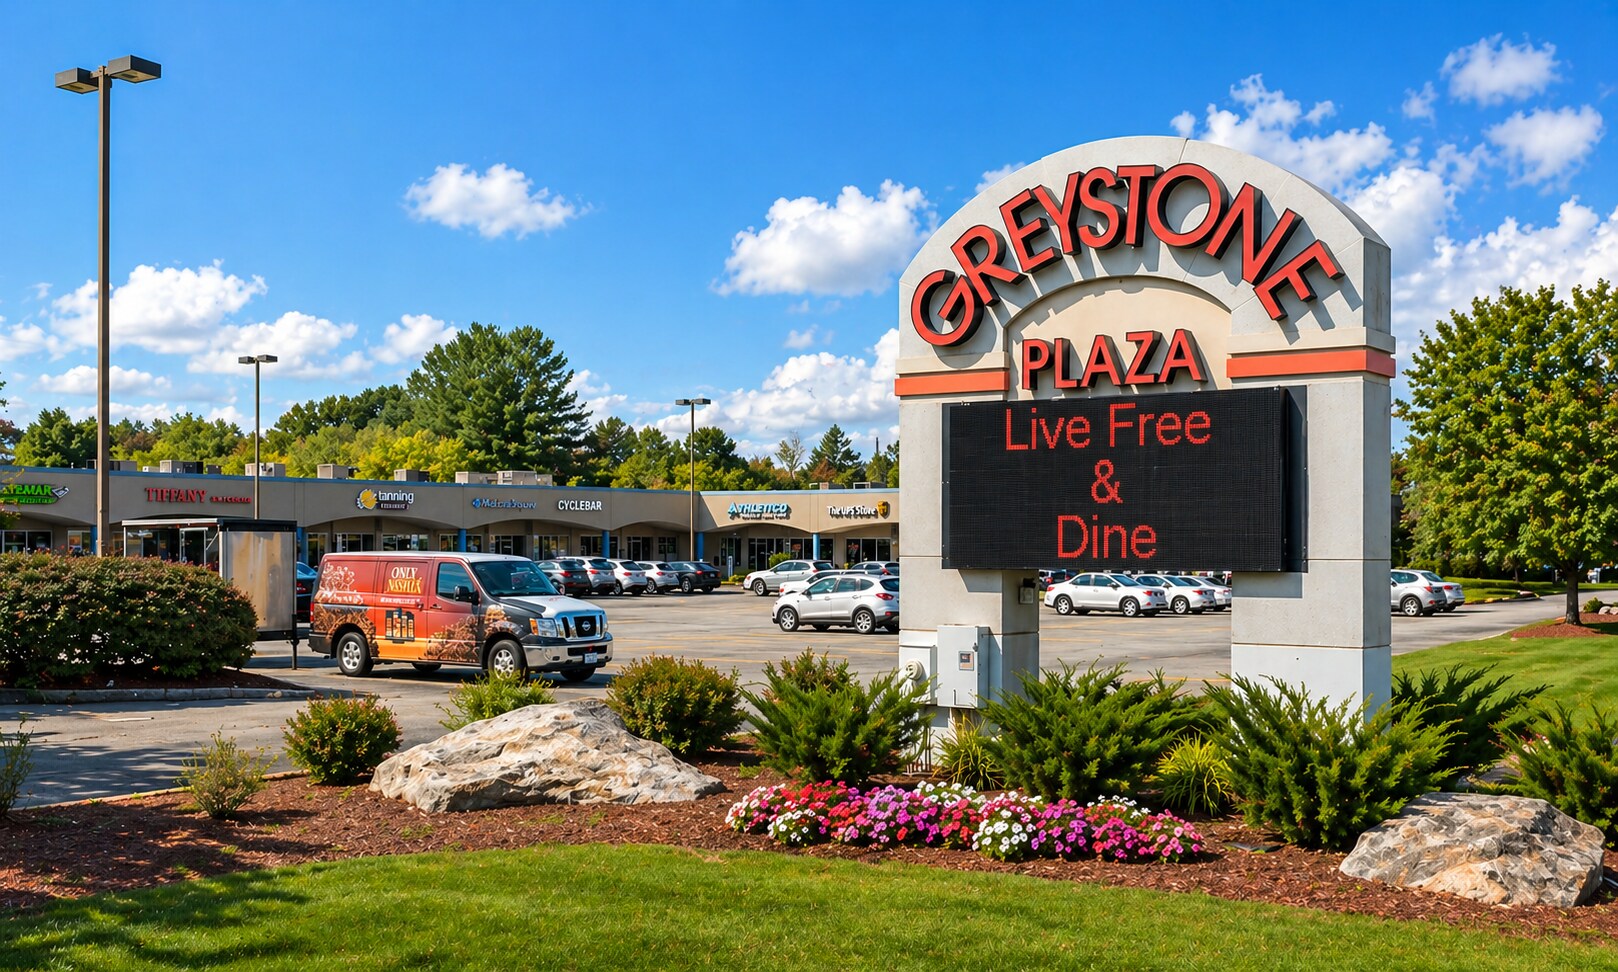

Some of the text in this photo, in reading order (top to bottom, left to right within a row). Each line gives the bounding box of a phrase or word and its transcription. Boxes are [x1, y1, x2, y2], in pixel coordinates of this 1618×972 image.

[911, 163, 1345, 347] GREYSTONE
[1022, 328, 1207, 390] PLAZA
[1005, 403, 1211, 450] Live Free
[145, 487, 207, 503] TIFFANY
[1091, 459, 1123, 504] &
[378, 490, 414, 504] tanning
[558, 500, 602, 510] CYCLEBAR
[827, 505, 876, 515] The UPS Store
[1057, 514, 1156, 559] Dine
[391, 566, 418, 579] ONLY
